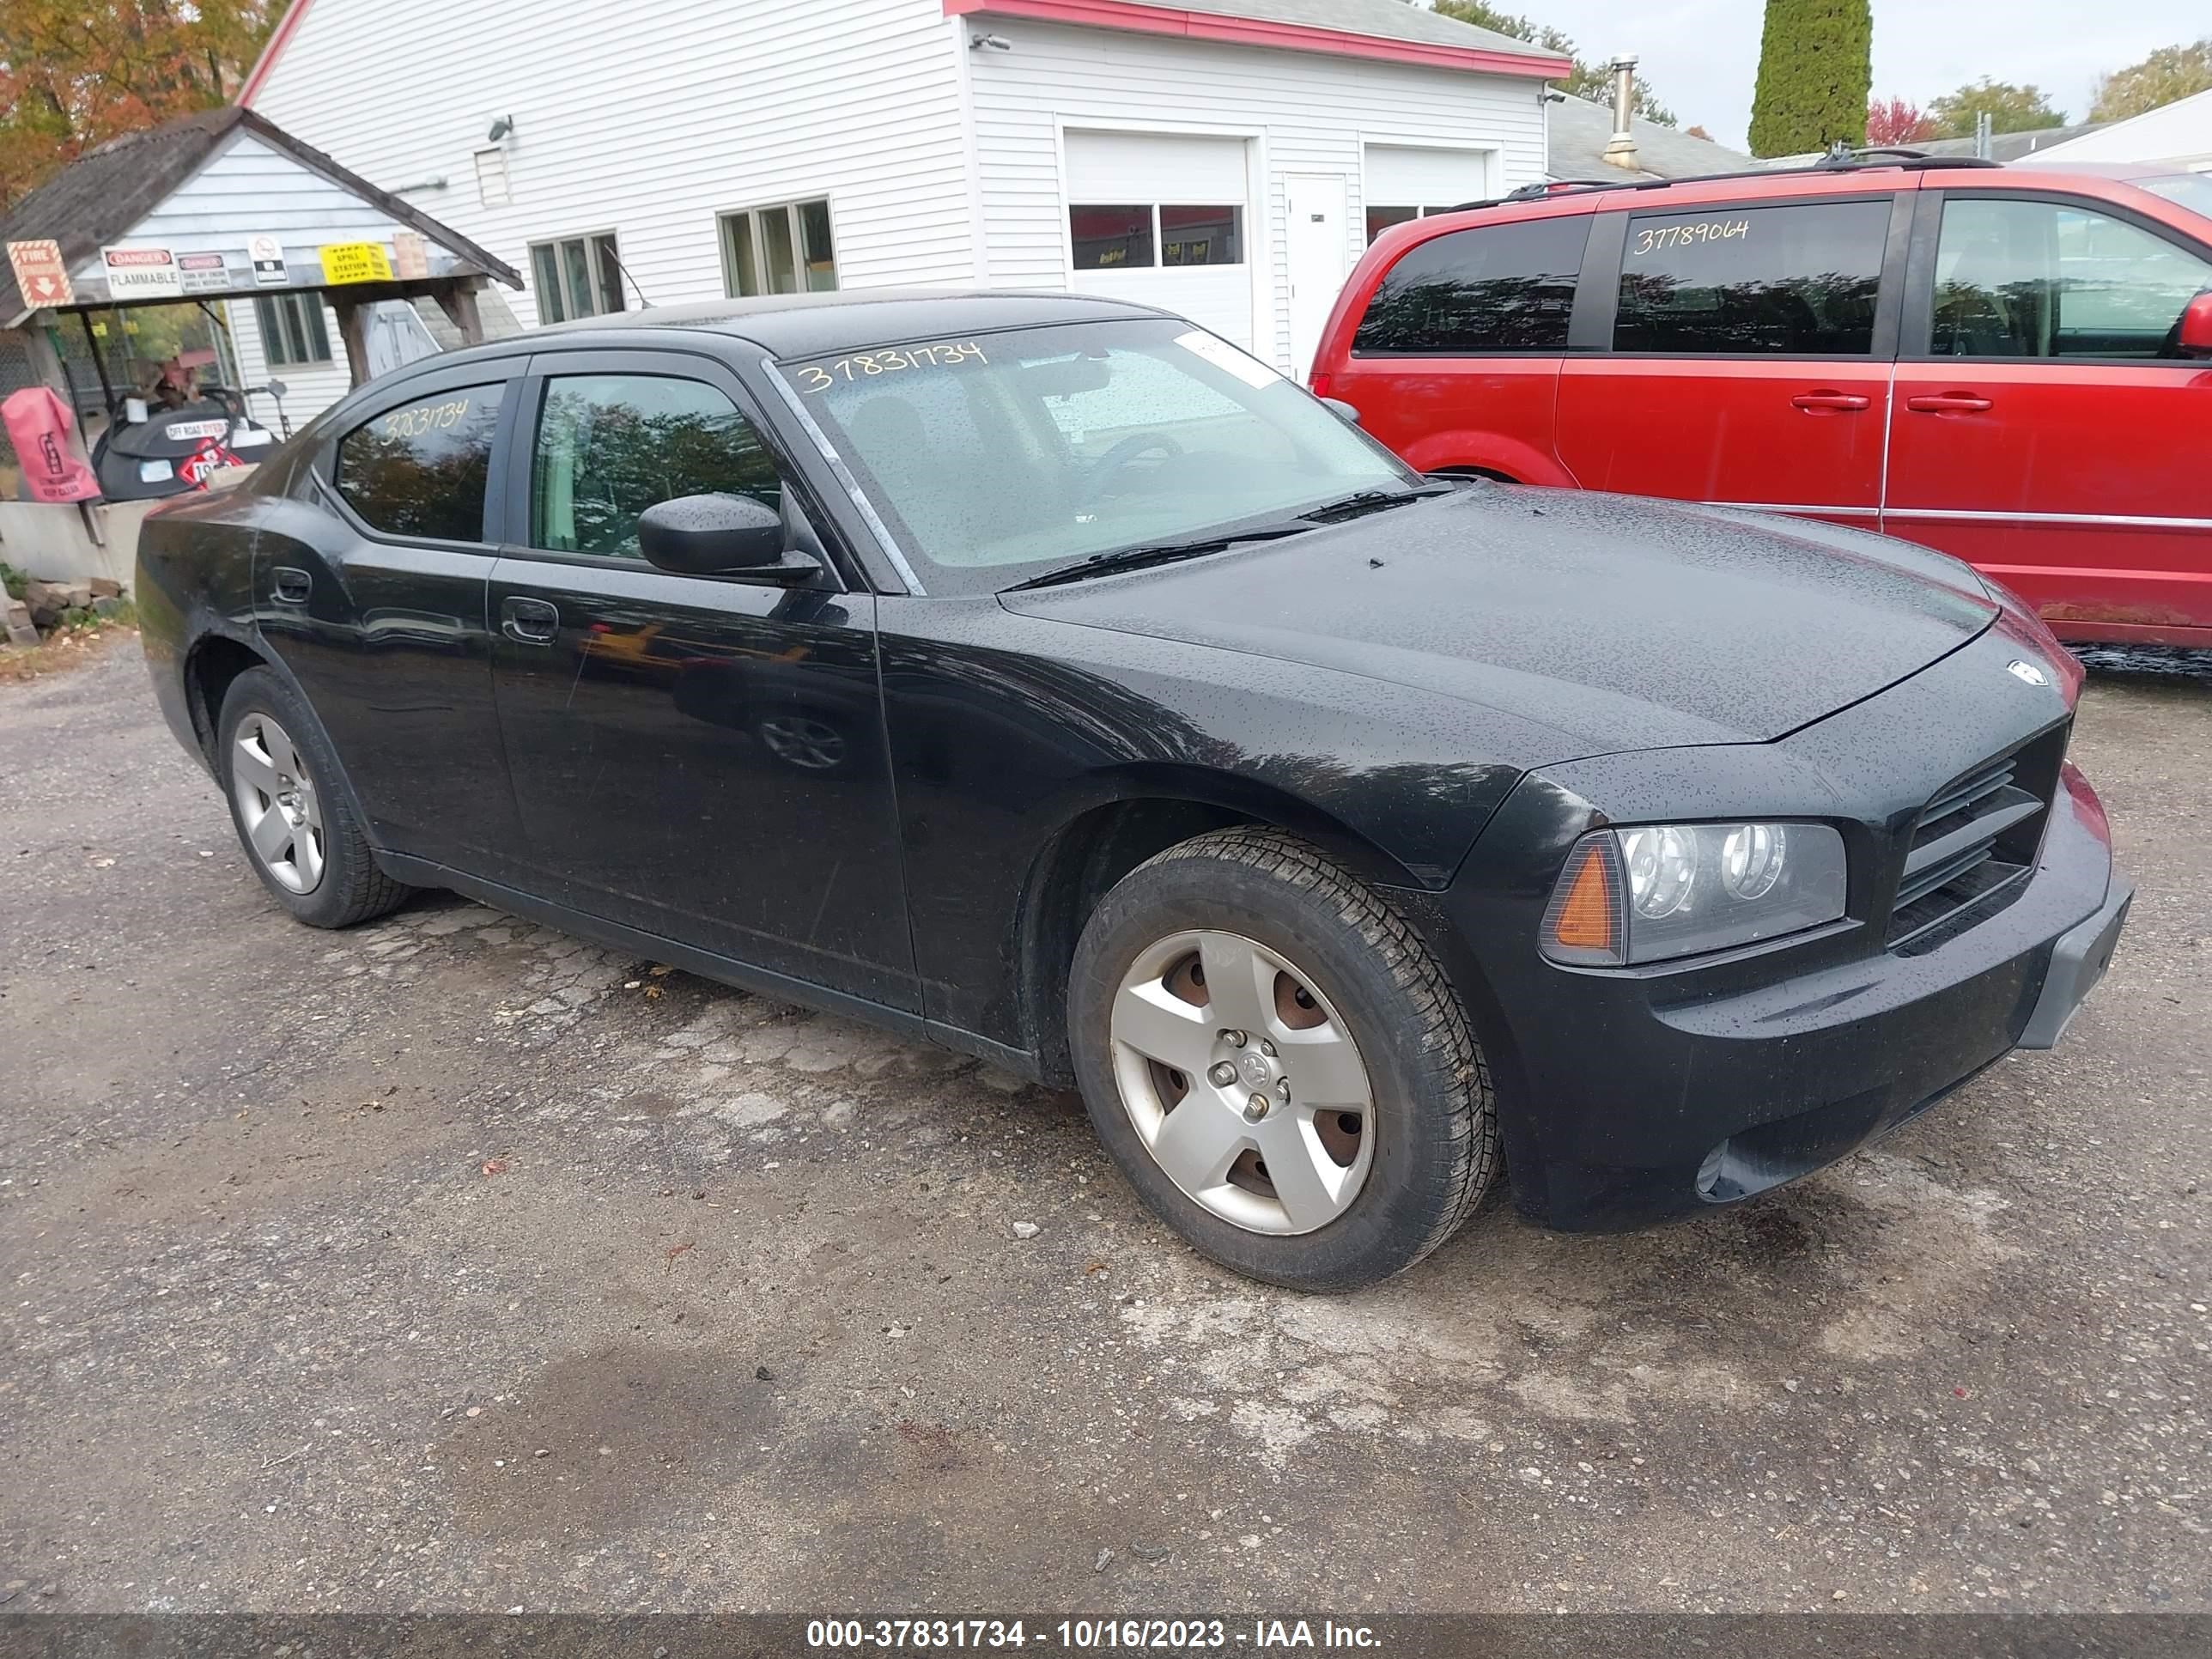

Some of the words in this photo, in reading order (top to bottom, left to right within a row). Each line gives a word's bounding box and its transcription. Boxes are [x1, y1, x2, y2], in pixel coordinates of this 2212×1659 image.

[1634, 220, 1749, 255] 37789064
[110, 271, 178, 286] FLAMMABLE
[798, 342, 988, 393] 37831734
[380, 398, 469, 447] 37831734
